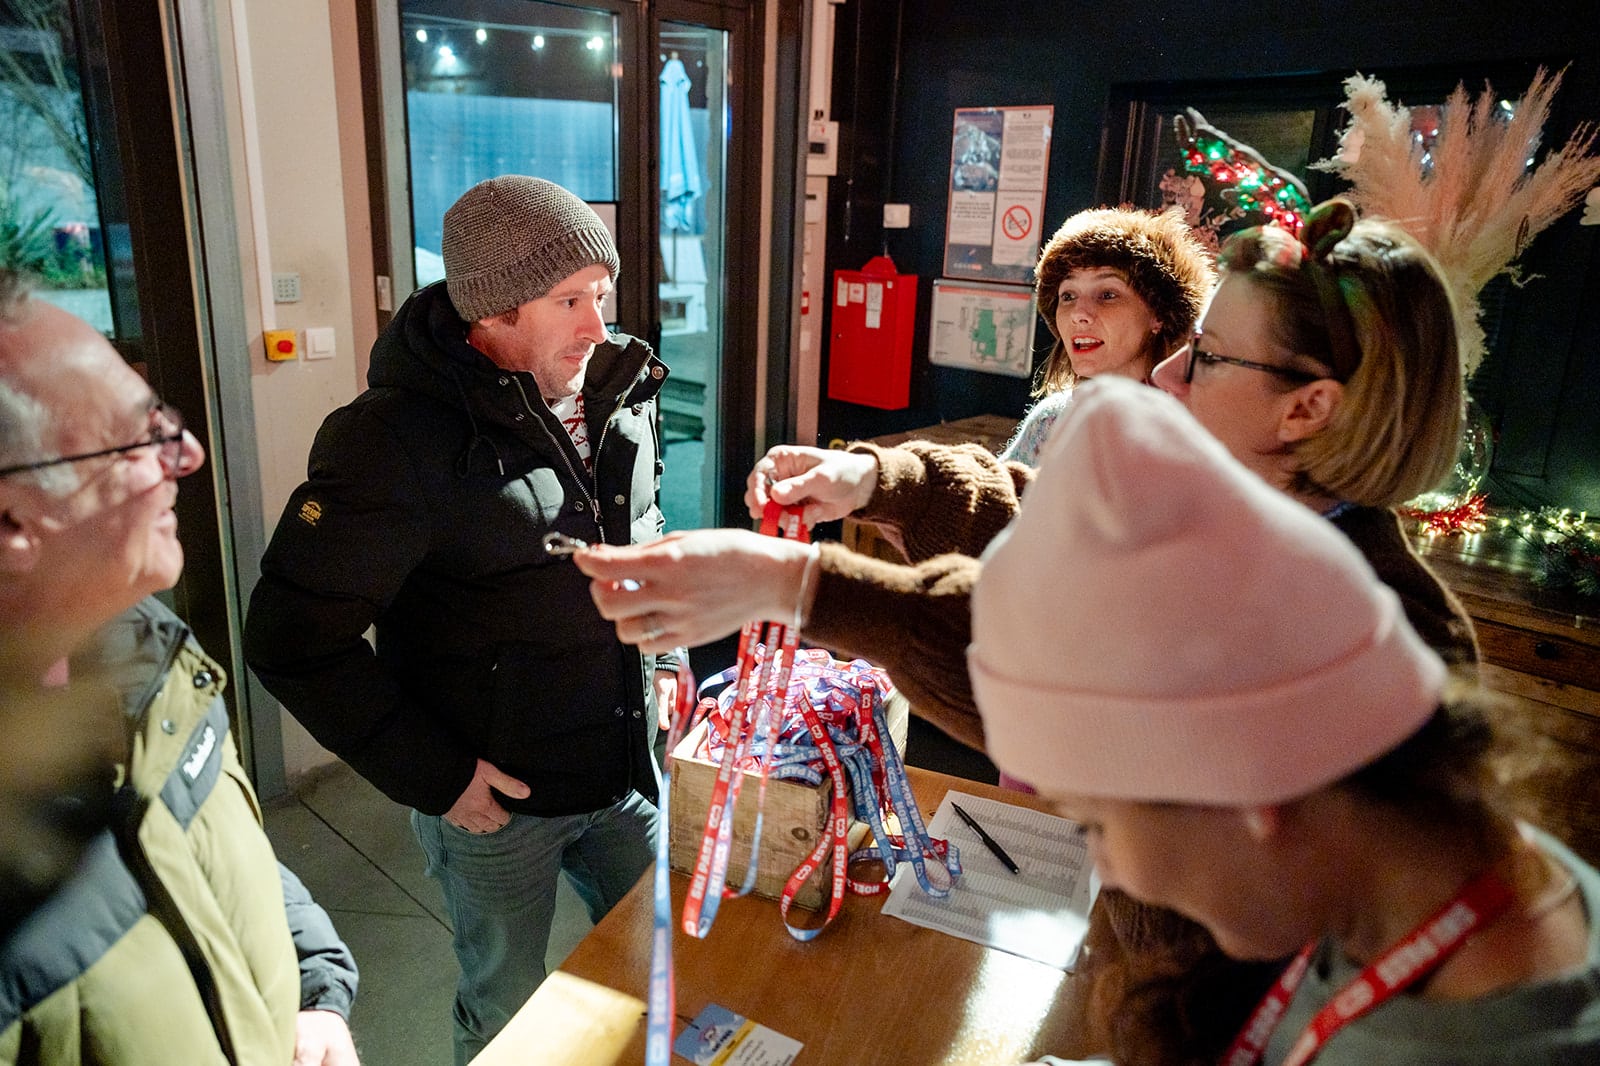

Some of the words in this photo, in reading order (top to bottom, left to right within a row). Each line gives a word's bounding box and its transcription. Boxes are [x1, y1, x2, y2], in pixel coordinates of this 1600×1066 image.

[718, 748, 734, 782] NOEL
[728, 710, 743, 745] 2024
[820, 742, 838, 767] 2024
[832, 768, 845, 799] NOEL
[900, 780, 915, 807] 2024
[895, 801, 910, 829] NOEL
[903, 831, 919, 858] 2024
[910, 808, 926, 835] NOEL
[697, 836, 714, 875] PASS
[812, 834, 831, 862] PASS
[835, 845, 845, 876] PASS
[689, 874, 707, 899] SKI
[834, 878, 843, 899] SKI
[853, 882, 880, 894] NOEL
